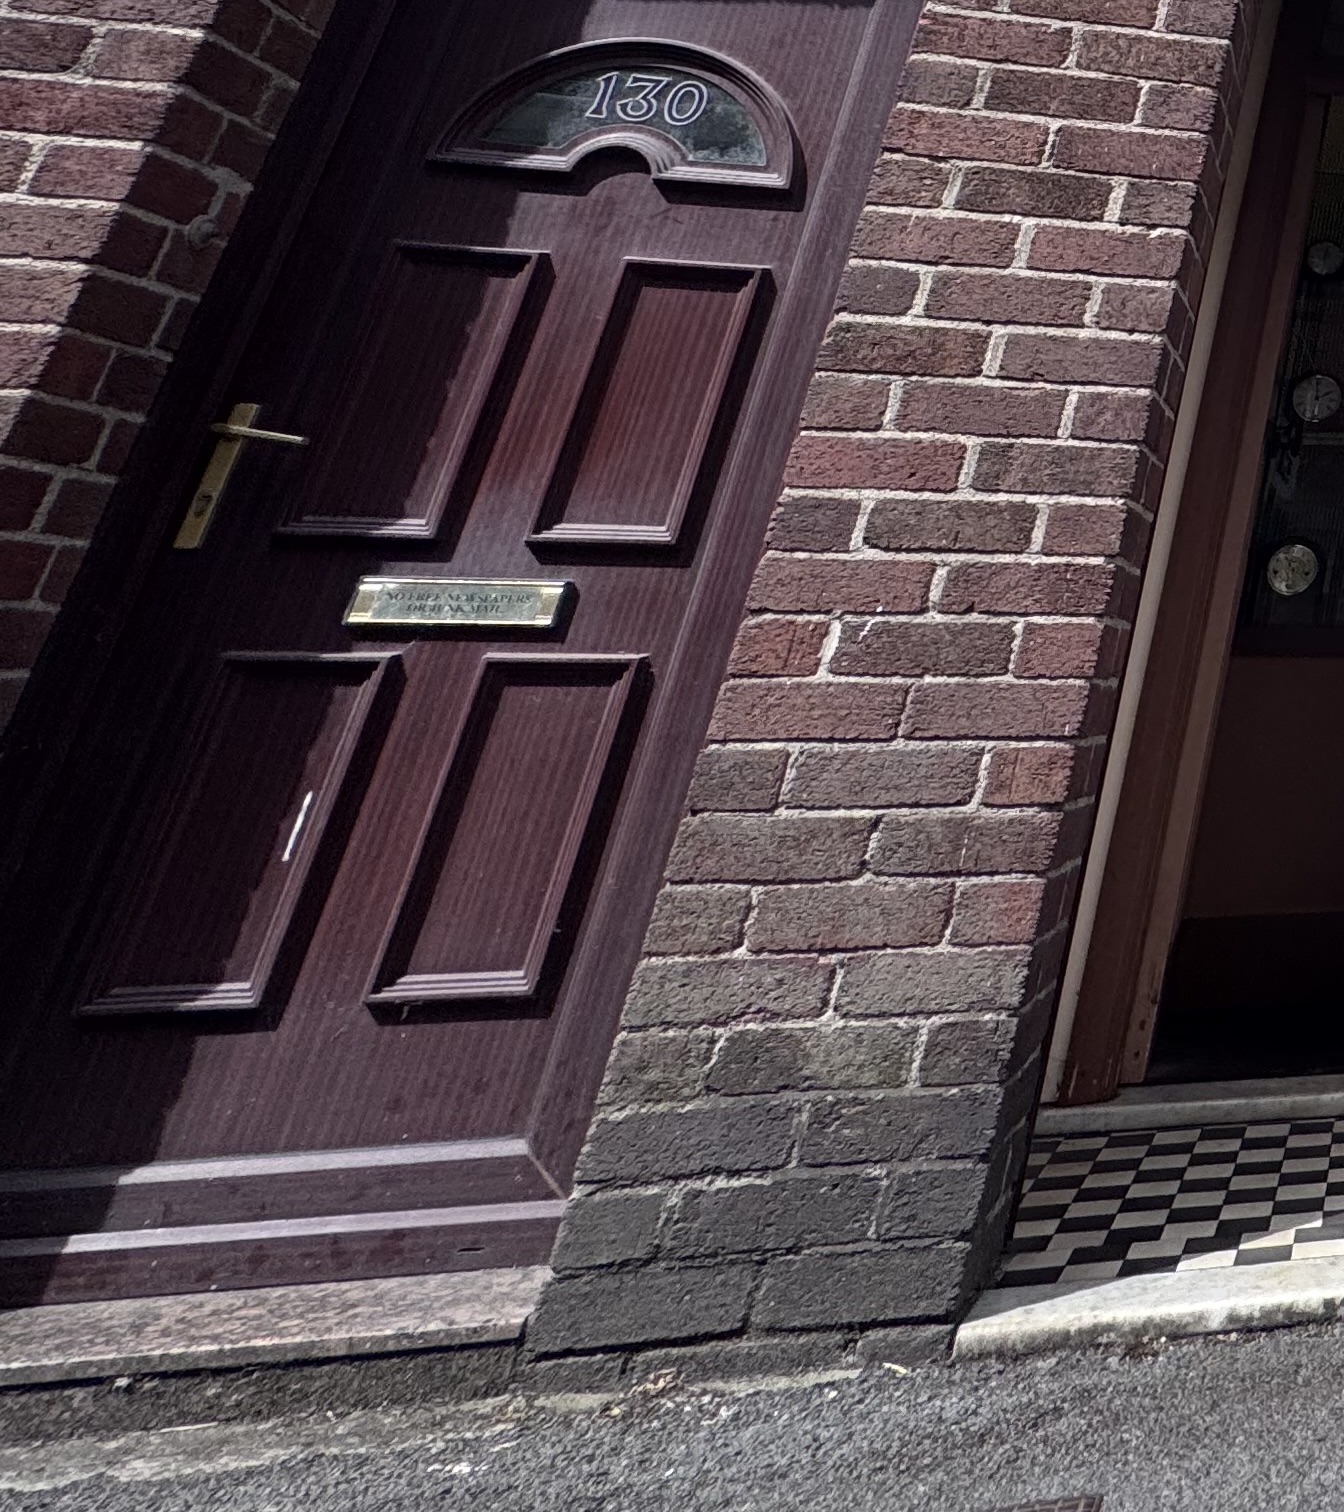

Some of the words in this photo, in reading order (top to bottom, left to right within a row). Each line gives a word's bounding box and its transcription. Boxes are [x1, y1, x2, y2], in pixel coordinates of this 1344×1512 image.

[585, 71, 709, 126] 130
[386, 591, 404, 601] NO
[407, 592, 441, 602] FREE
[447, 592, 533, 604] NEWSPAPERS
